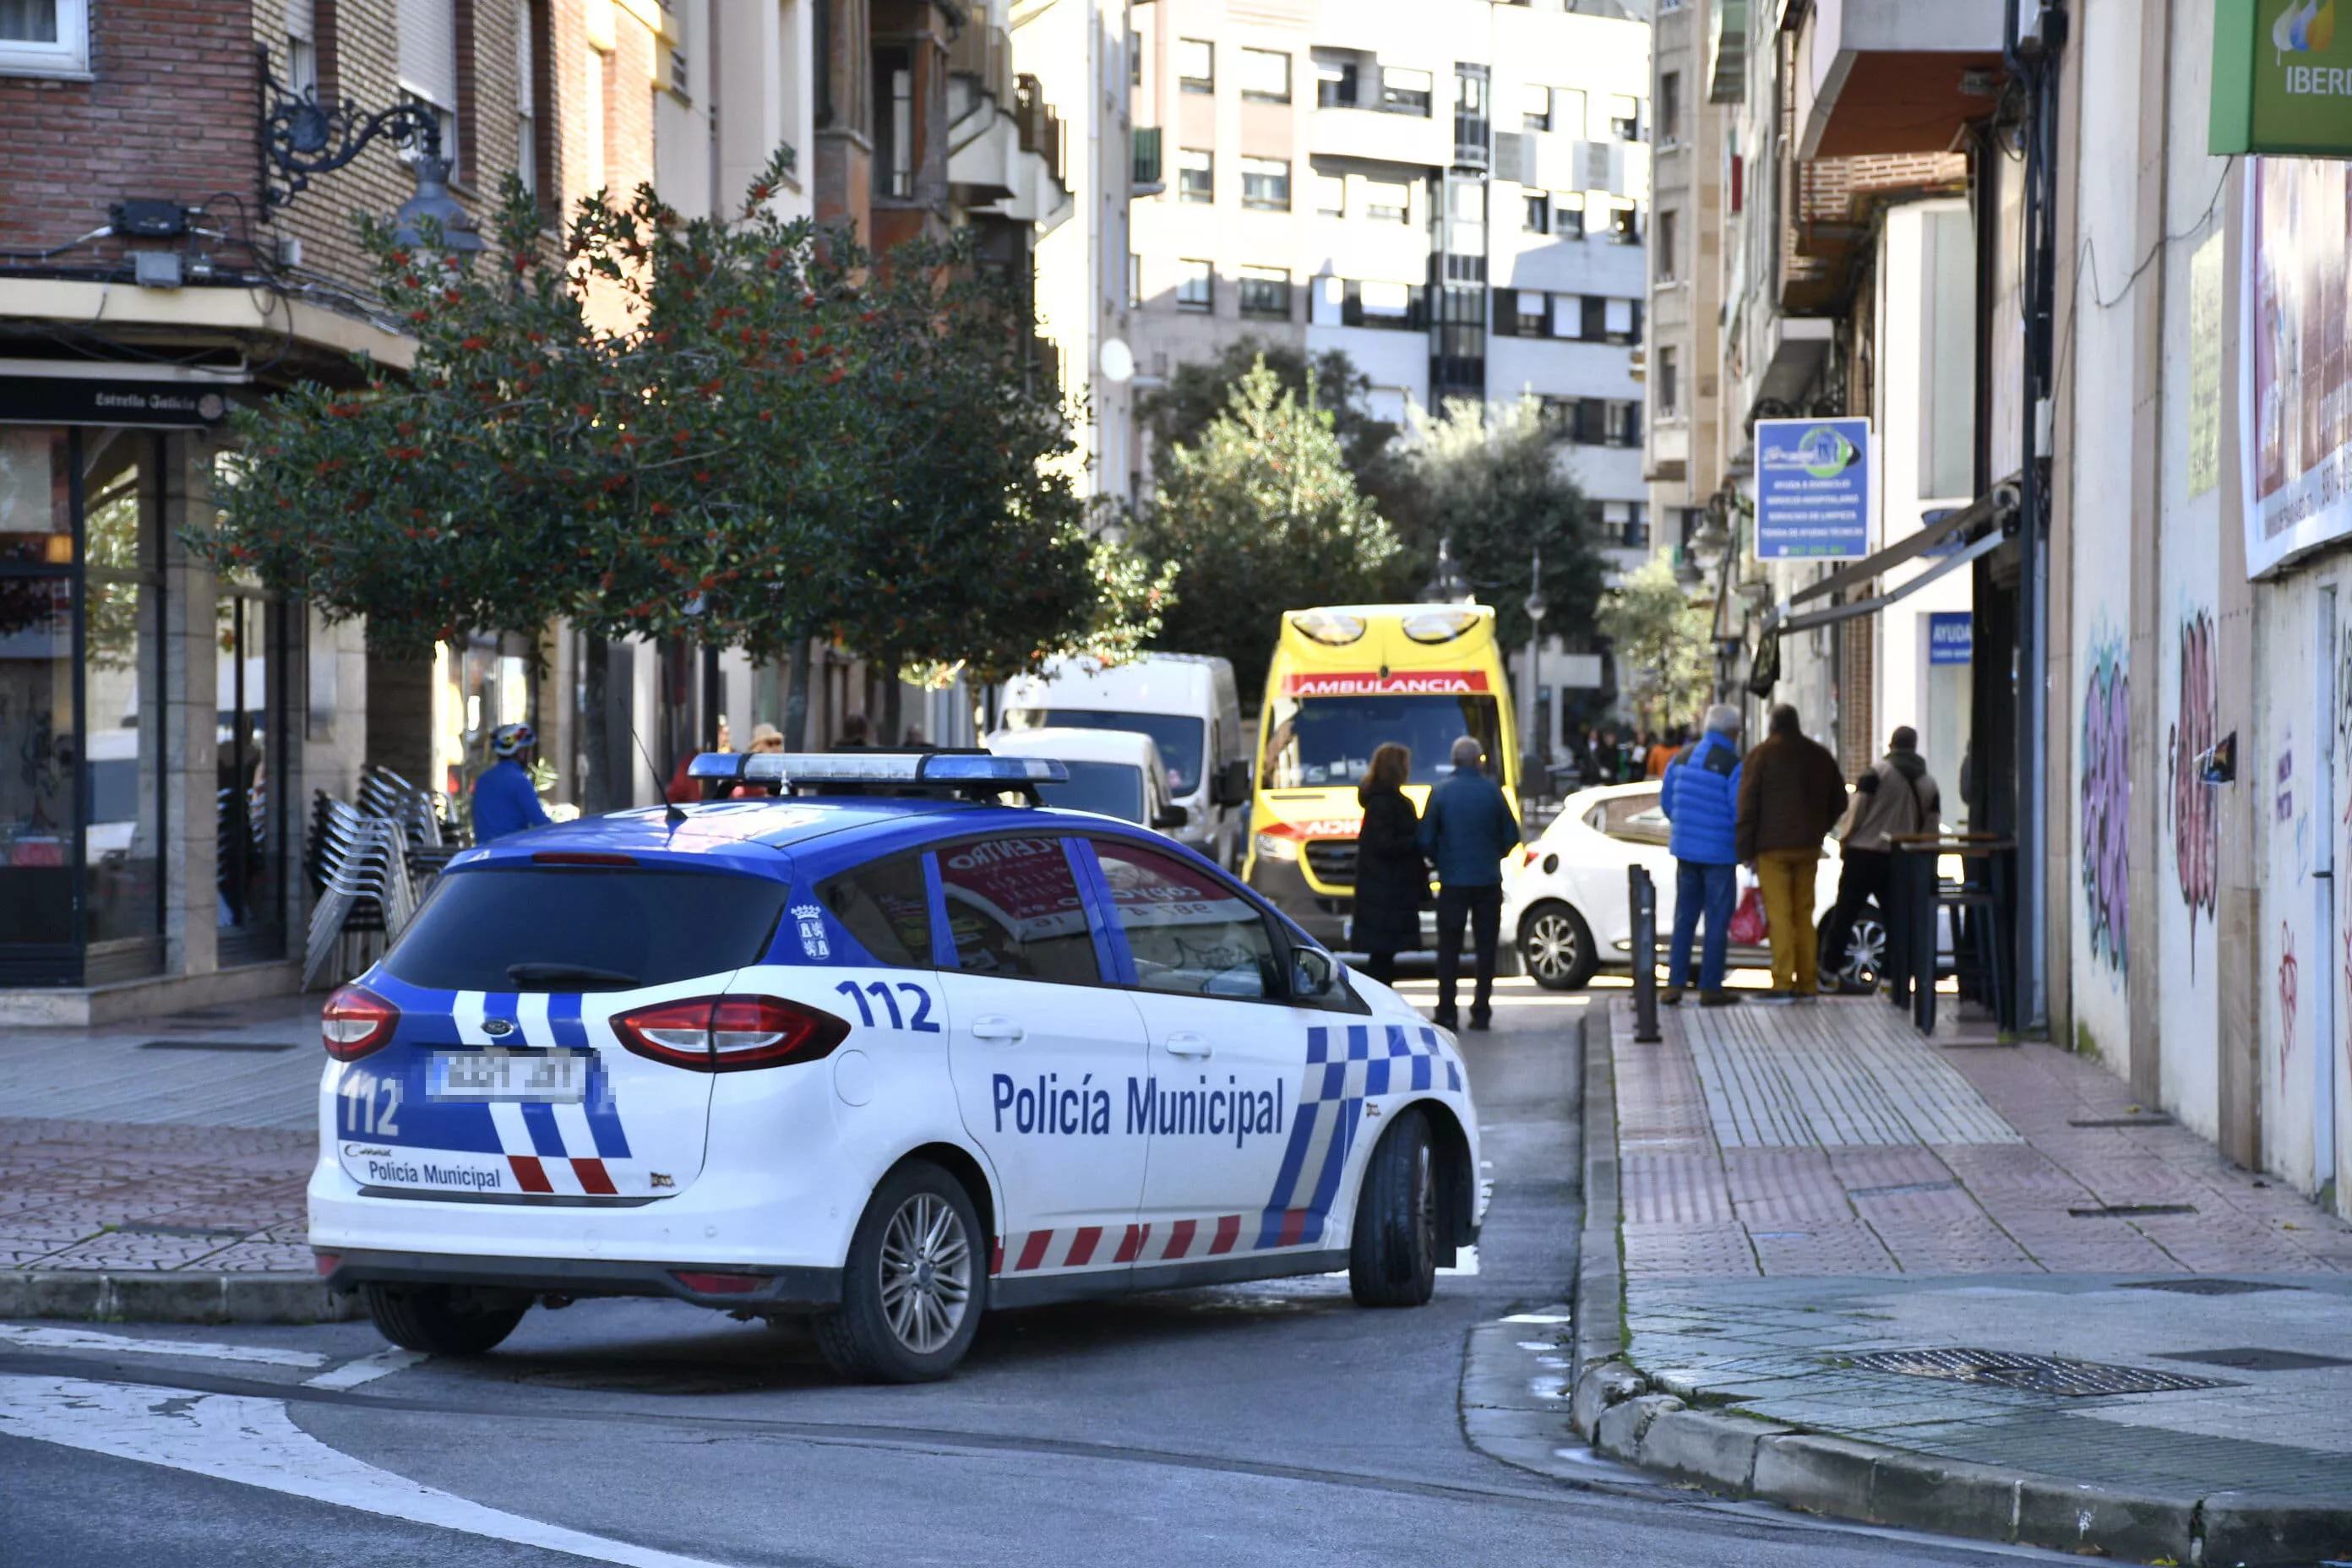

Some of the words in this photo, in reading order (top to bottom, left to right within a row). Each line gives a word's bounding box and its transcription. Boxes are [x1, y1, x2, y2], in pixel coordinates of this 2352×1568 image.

[95, 392, 145, 408] Estrella
[149, 395, 195, 410] Galicia
[1297, 678, 1471, 694] AMBULANCIA
[835, 980, 940, 1033] 112
[342, 1070, 400, 1137] 112
[993, 1073, 1111, 1135] Policía
[1126, 1075, 1283, 1149] Municipal
[368, 1161, 419, 1183] Policía
[424, 1163, 502, 1190] Municipal
